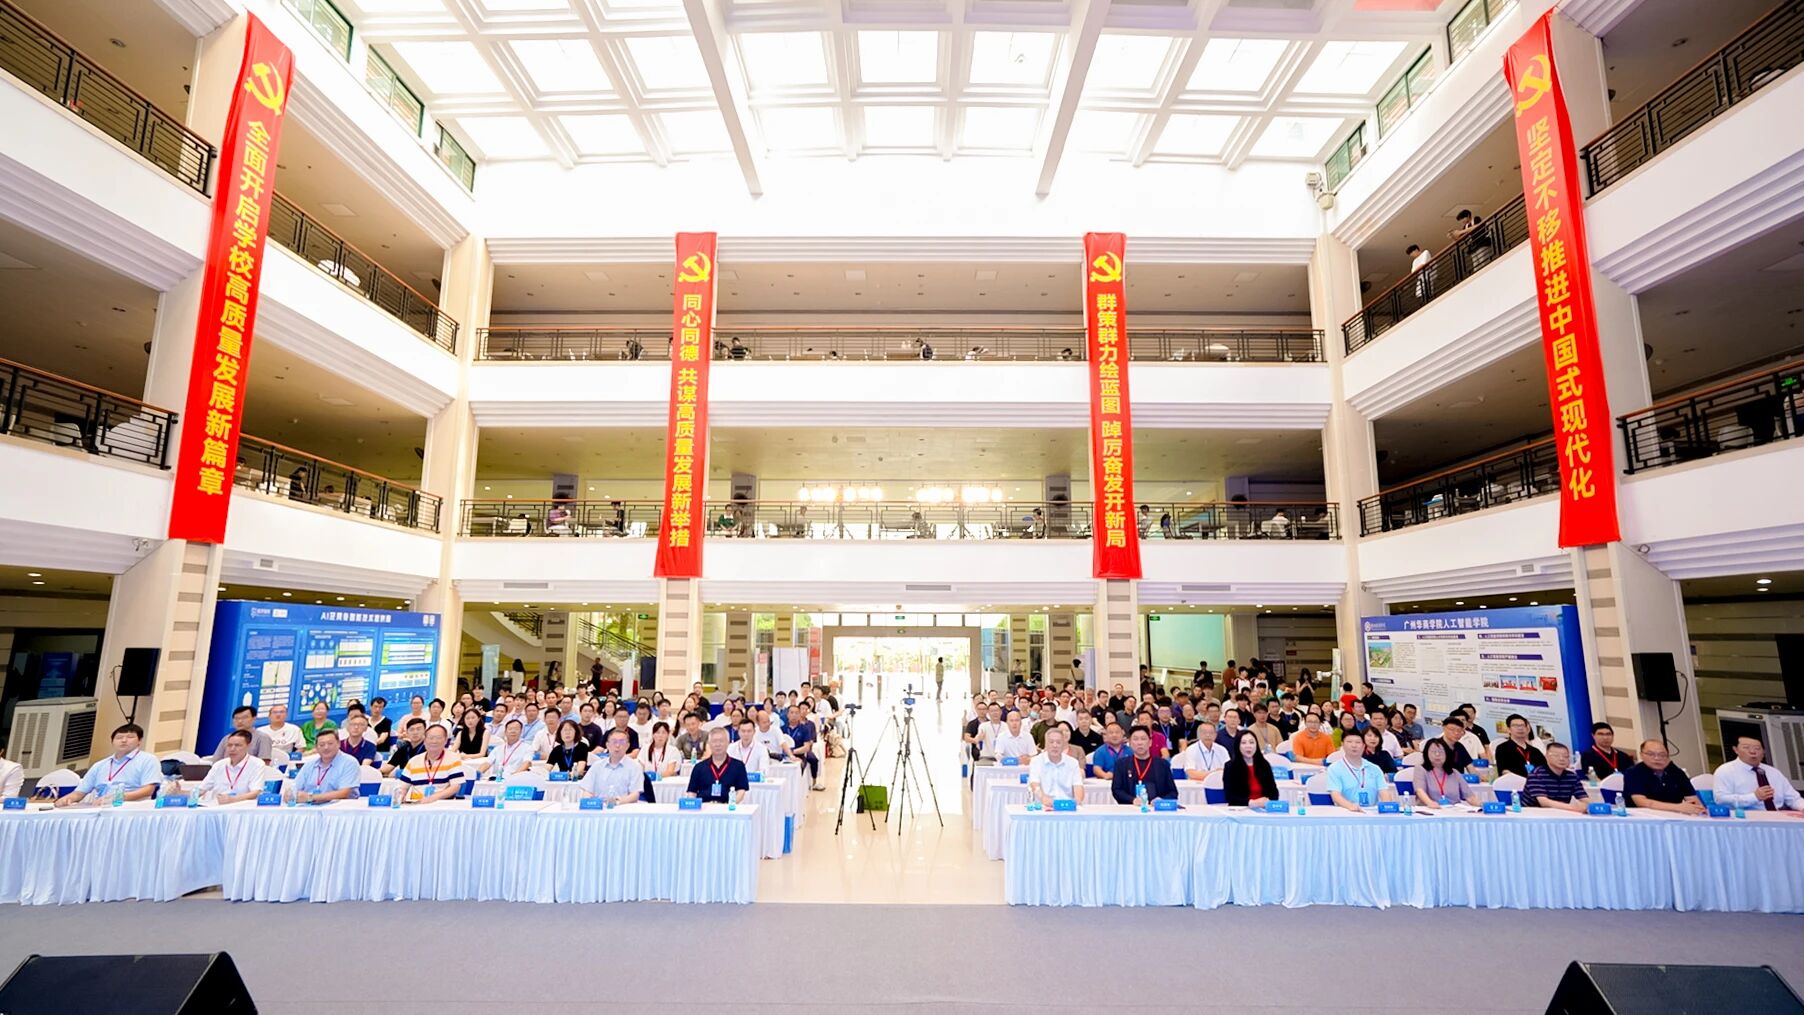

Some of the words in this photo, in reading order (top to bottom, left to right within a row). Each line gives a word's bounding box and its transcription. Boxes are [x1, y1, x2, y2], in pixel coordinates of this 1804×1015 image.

[197, 120, 271, 496] 全面开启学校高质量发展新篇章
[679, 294, 702, 361] 同心同德
[1096, 293, 1121, 414] 群策群力绘蓝图
[1527, 115, 1596, 501] 坚定不移推进中国式现代化
[669, 367, 698, 547] 共谋高质量发展新举措
[1101, 420, 1126, 547] 踔厉奋发开新局
